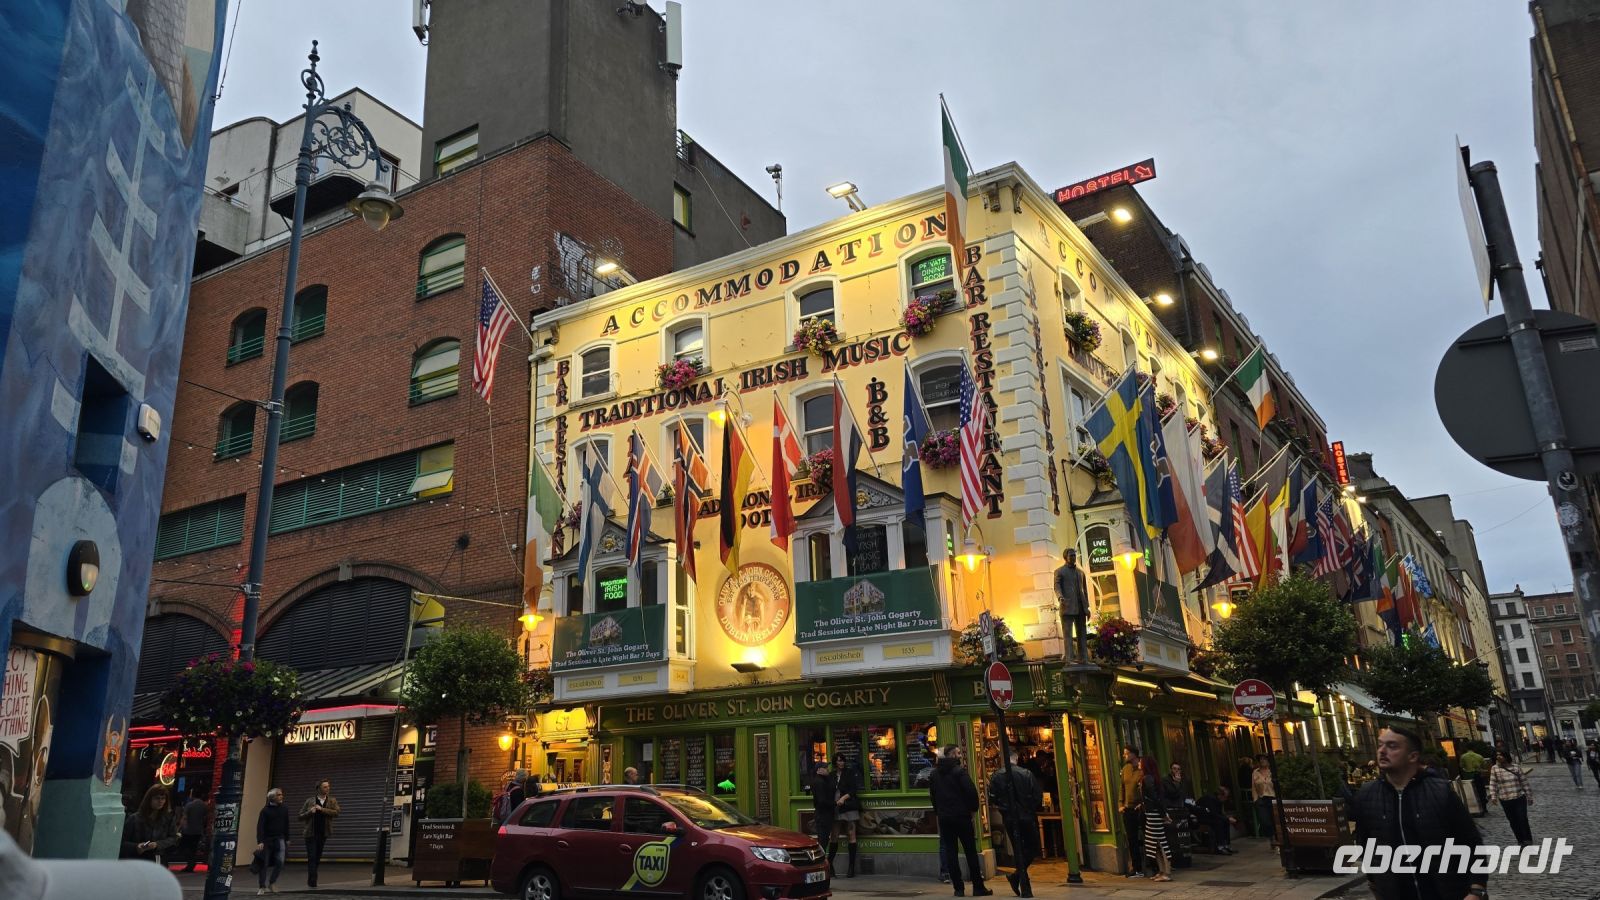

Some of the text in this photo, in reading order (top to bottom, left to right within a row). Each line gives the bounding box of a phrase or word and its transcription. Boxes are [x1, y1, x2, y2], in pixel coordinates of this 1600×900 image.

[1059, 170, 1136, 202] HOSTEL
[600, 211, 947, 338] ACCOMMODATION
[921, 264, 946, 277] DINING
[740, 356, 809, 393] IRISH
[821, 332, 910, 373] MUSIC
[555, 360, 570, 406] BAR
[963, 245, 1004, 519] BAR RESTAURANT
[867, 378, 890, 452] B&B
[1334, 443, 1349, 483] HOSTEL
[1092, 556, 1111, 564] MUSIC
[604, 584, 623, 593] IRISH
[604, 591, 624, 600] FOOD
[721, 609, 784, 641] DUBLIN IRELAND
[814, 609, 921, 628] The Oliver St. John Gogarty
[800, 630, 817, 639] Trad
[817, 627, 848, 636] Sessions
[857, 625, 873, 633] Late
[874, 622, 896, 632] Night
[897, 620, 911, 628] Bar
[918, 618, 938, 628] Days
[566, 650, 577, 658] The
[577, 648, 597, 656] Oliver
[607, 645, 623, 655] John
[623, 643, 649, 653] Gogarty
[568, 659, 592, 667] Sessions
[612, 654, 629, 664] Night
[645, 651, 660, 660] Days
[1051, 684, 1063, 696] 58
[626, 687, 891, 724] THE OLIVER ST. JOHN GOGARTY
[300, 723, 342, 741] NO ENTRY
[434, 833, 445, 841] Night
[639, 855, 665, 871] TAXI
